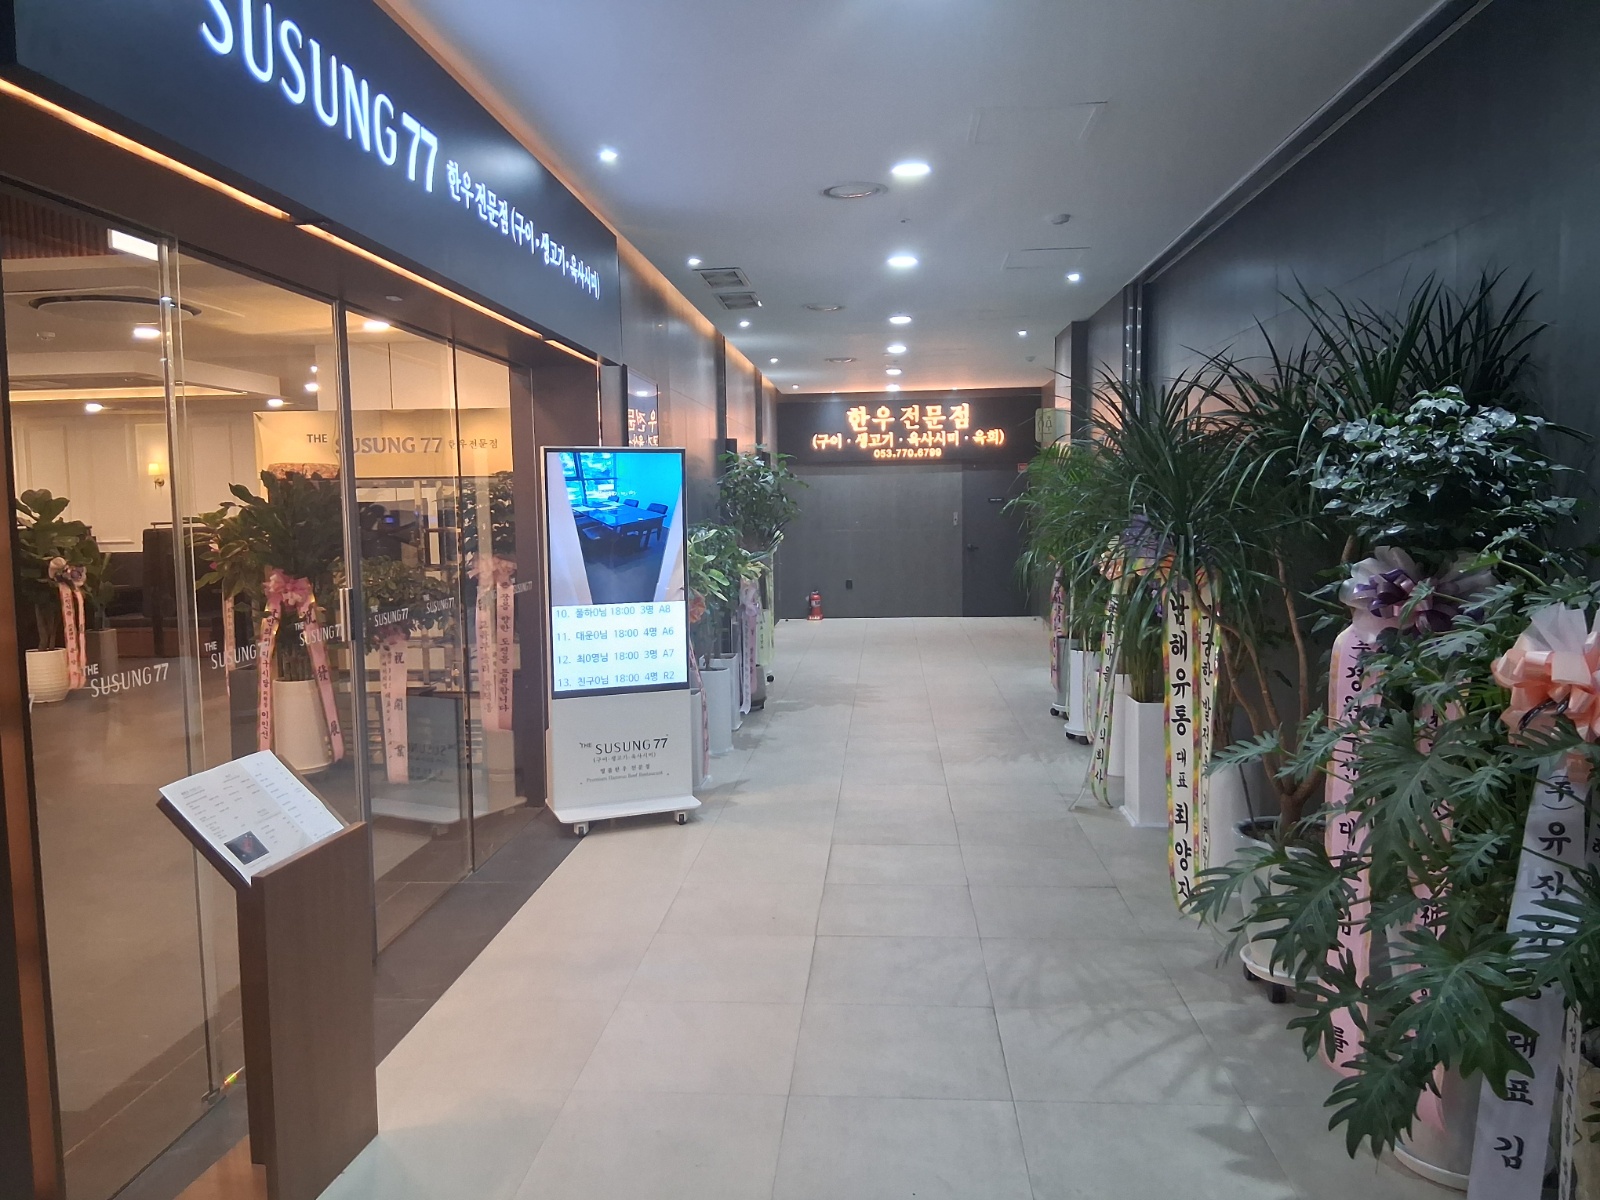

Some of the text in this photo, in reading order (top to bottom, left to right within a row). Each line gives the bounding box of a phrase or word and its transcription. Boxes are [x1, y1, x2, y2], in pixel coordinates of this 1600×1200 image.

[200, 0, 438, 193] SUSUNG 77
[307, 434, 328, 443] THE
[420, 437, 443, 453] 77
[556, 609, 570, 618] 10.
[611, 606, 635, 615] 18:00
[640, 605, 654, 614] 3명
[658, 605, 671, 613] A8
[295, 622, 304, 630] THE
[557, 632, 571, 641] 11.
[614, 629, 638, 638] 18:00
[643, 627, 657, 637] 4명
[662, 627, 674, 636] A6
[204, 641, 218, 652] THE
[211, 644, 257, 669] SUSUNG
[558, 655, 571, 664] 12.
[614, 651, 639, 661] 18:00
[644, 649, 658, 659] 3명
[662, 649, 674, 658] A7
[83, 663, 99, 676] THE
[91, 662, 169, 698] SUSUNG 77
[558, 678, 571, 687] 13.
[615, 673, 640, 683] 18:00
[644, 672, 658, 682] 4명
[663, 671, 675, 680] R2
[595, 740, 651, 755] SUSUNG
[653, 737, 669, 749] 77
[1175, 748, 1189, 789] 대표
